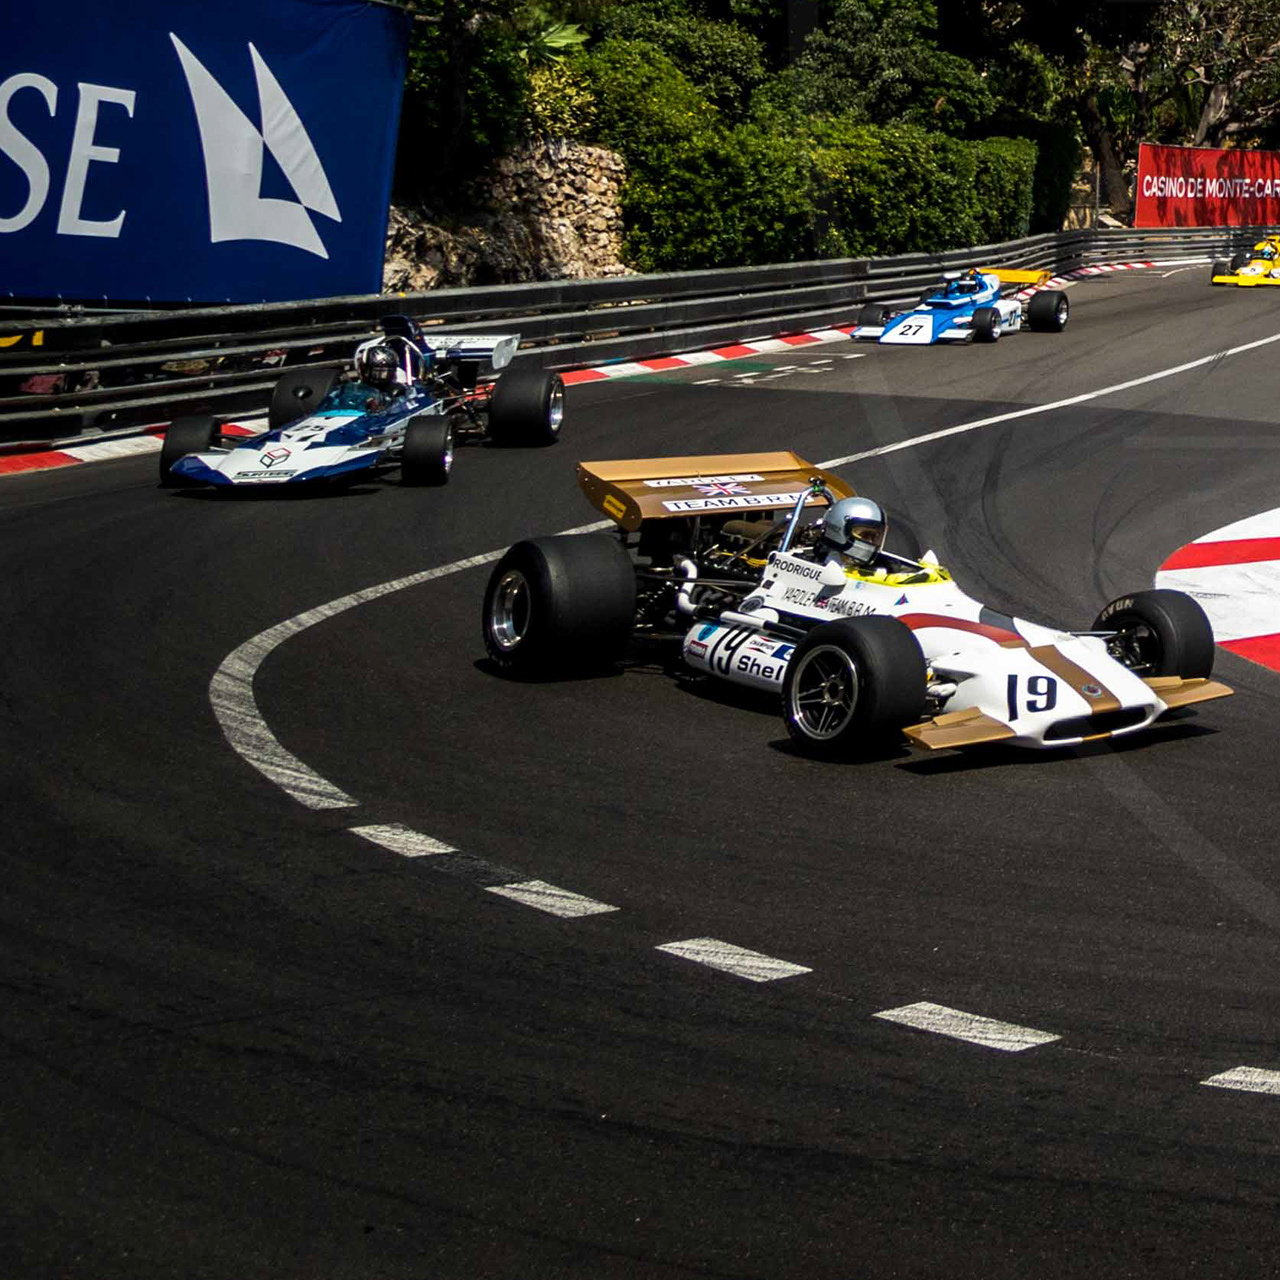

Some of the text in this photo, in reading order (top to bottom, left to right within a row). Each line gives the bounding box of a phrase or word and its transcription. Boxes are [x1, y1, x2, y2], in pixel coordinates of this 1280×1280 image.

[1143, 175, 1186, 198] CASINO
[1187, 178, 1204, 198] DE
[899, 323, 925, 337] 27
[667, 498, 739, 511] TEAM
[772, 558, 822, 582] RODRIGUE
[1101, 598, 1134, 621] AVON
[749, 639, 775, 652] CHAMPION
[736, 654, 784, 681] Shel
[1007, 674, 1058, 722] 19
